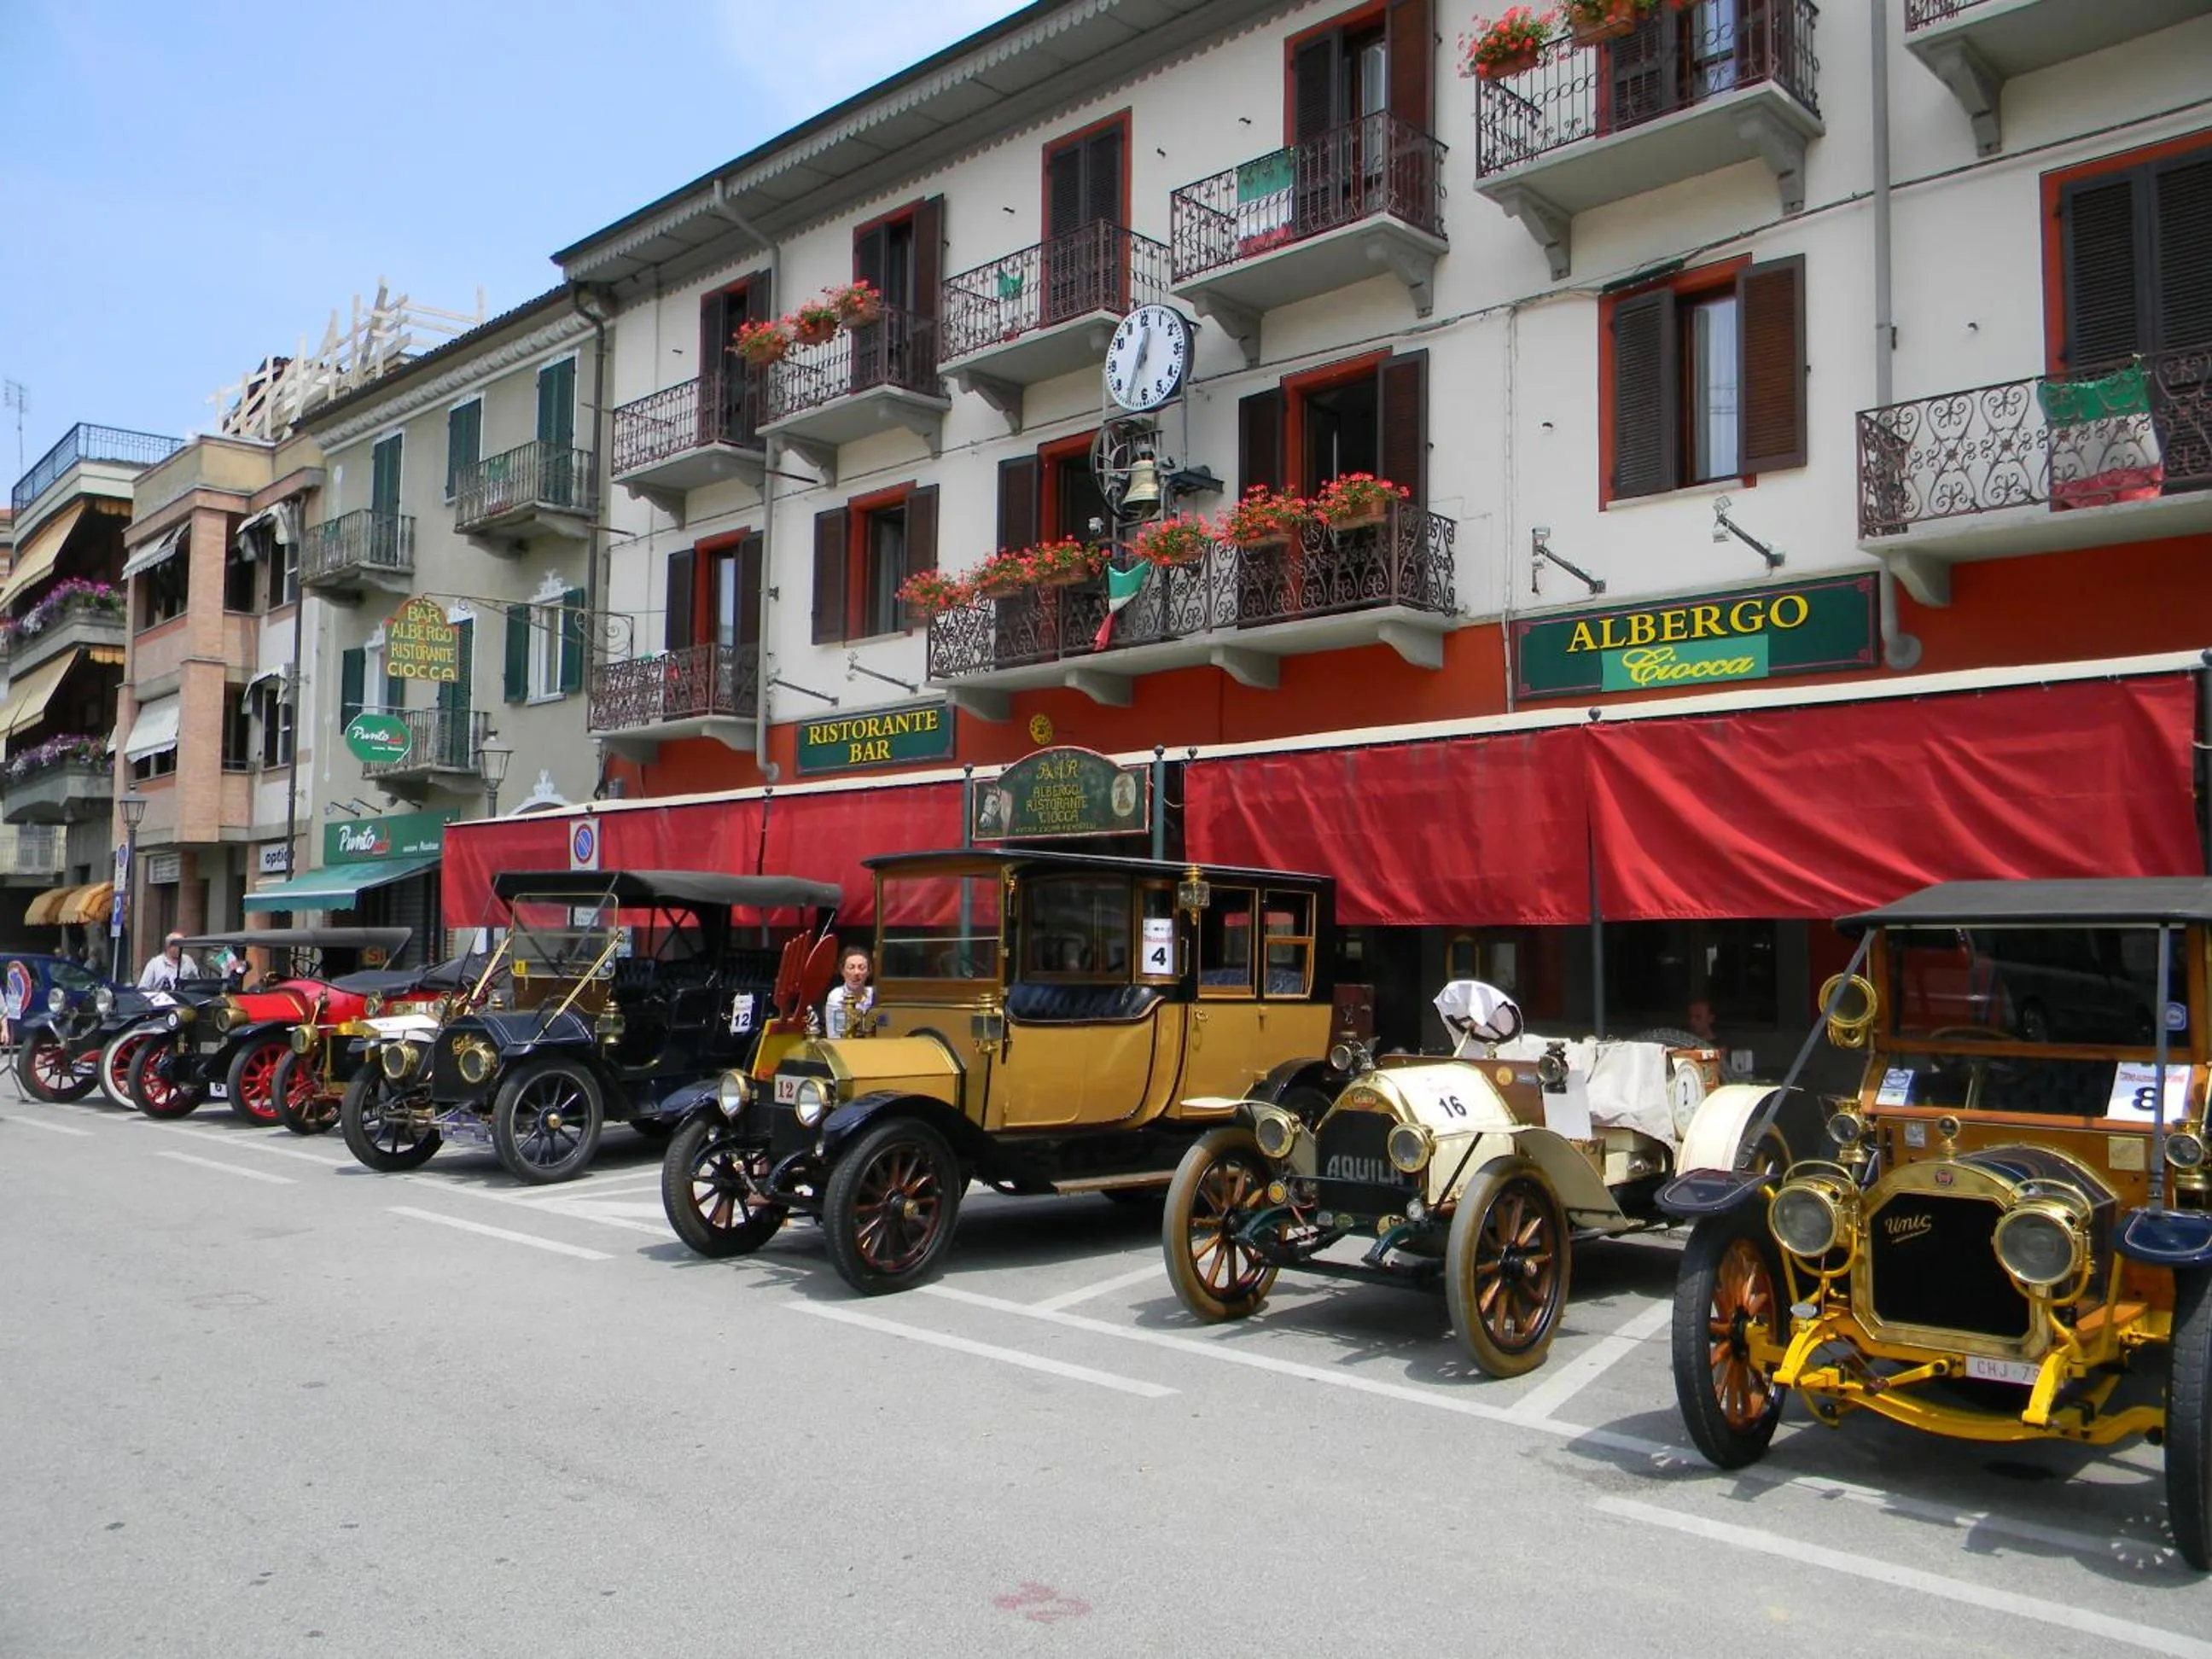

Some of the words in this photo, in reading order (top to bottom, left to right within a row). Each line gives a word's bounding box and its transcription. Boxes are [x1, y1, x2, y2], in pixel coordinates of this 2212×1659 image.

[1140, 315, 1149, 327] 12
[1167, 324, 1173, 336] 2
[1173, 342, 1179, 356] 3
[1111, 360, 1117, 372] 9
[1167, 364, 1173, 375] 4
[1116, 378, 1122, 392] 8
[1141, 388, 1148, 400] 6
[1156, 380, 1162, 393] 5
[408, 605, 440, 624] BAR
[1566, 594, 1810, 654] ALBERGO
[391, 621, 452, 643] ALBERGO
[391, 641, 455, 663] RISTORANTE
[387, 661, 455, 681] CIOCCA
[1621, 647, 1756, 687] Ciocca
[352, 725, 390, 742] Punto
[807, 709, 939, 746] RISTORANTE
[848, 739, 892, 764] BAR
[1026, 795, 1088, 812] RISTORANTE
[339, 824, 375, 853] Punto
[1151, 947, 1166, 966] 4
[735, 1013, 749, 1027] 12
[778, 1081, 794, 1098] 12
[2132, 1086, 2157, 1112] 8
[1439, 1095, 1467, 1119] 16
[1327, 1155, 1404, 1185] AQUILA
